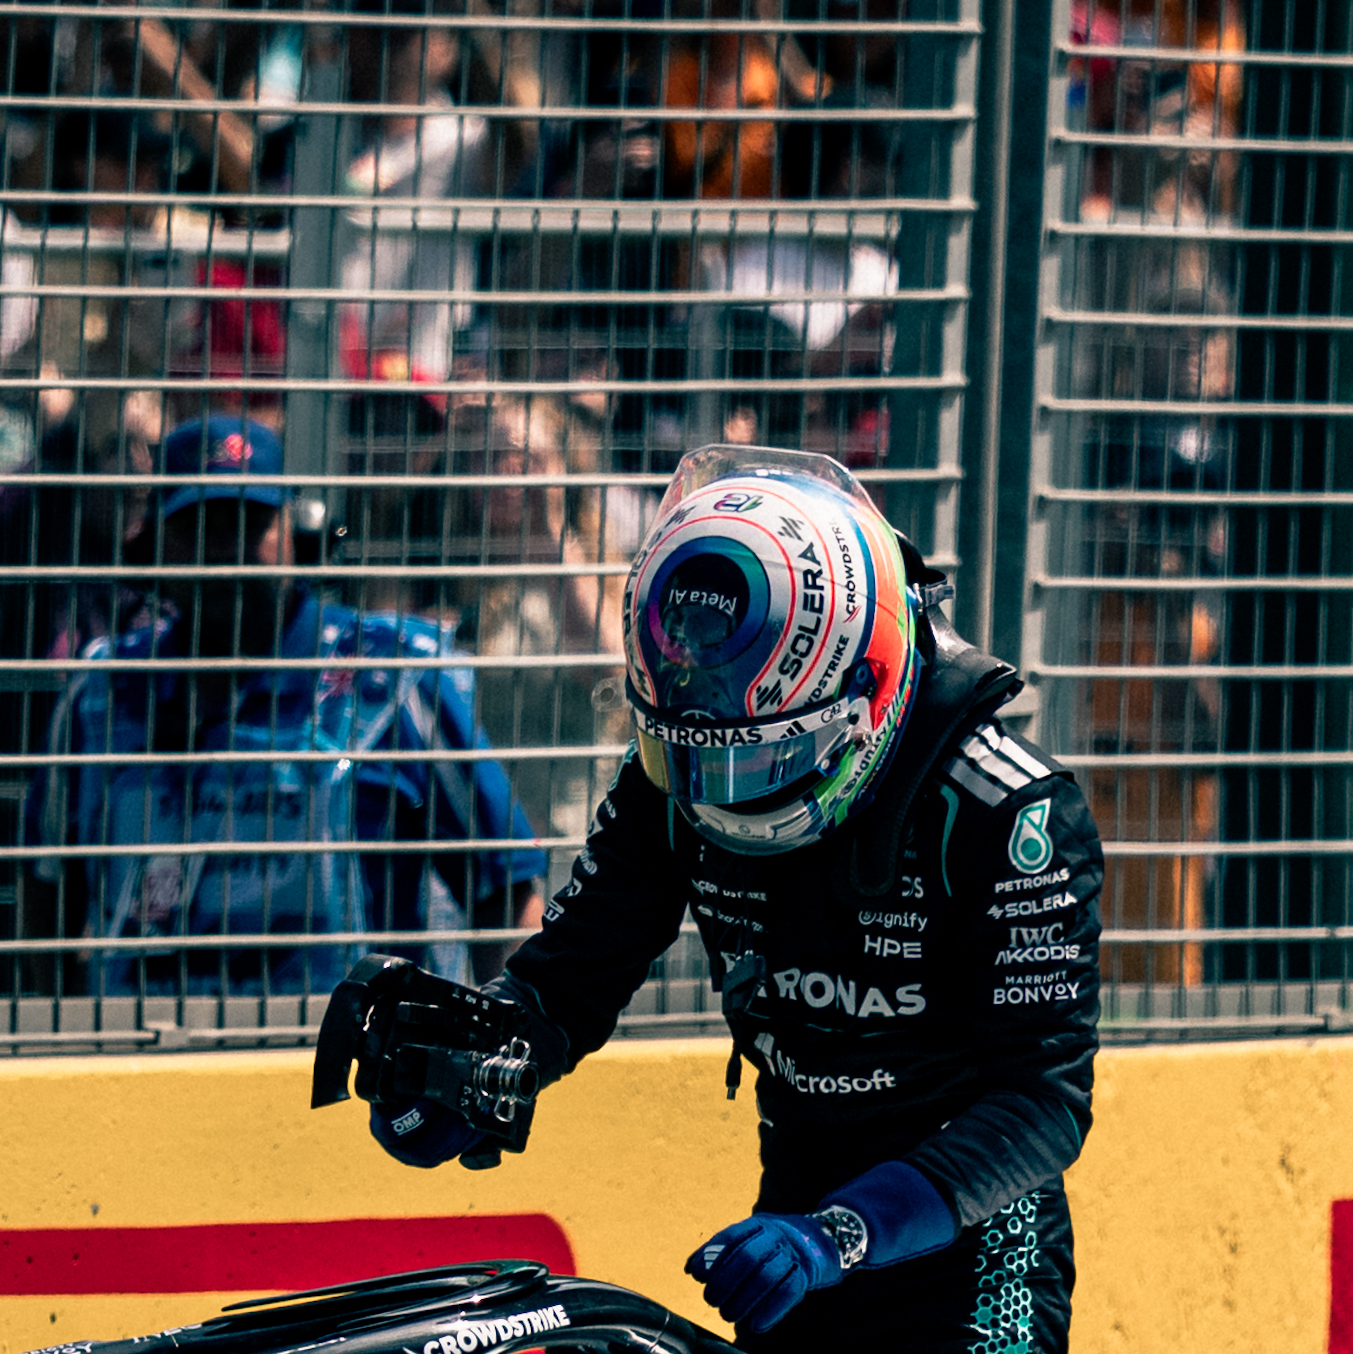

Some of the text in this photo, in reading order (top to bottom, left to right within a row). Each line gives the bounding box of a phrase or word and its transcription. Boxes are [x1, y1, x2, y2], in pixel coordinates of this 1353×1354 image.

[667, 588, 738, 615] Meta AI
[778, 541, 825, 682] SOLERA
[645, 720, 763, 747] PETRONAS
[995, 867, 1070, 893] PETRONAS
[1004, 891, 1078, 918] SOLERA
[864, 935, 922, 959] HPE
[1009, 922, 1065, 948] IWC
[1005, 970, 1067, 985] MARRIOTT
[993, 982, 1080, 1005] BONVOY
[393, 1111, 422, 1133] OMP
